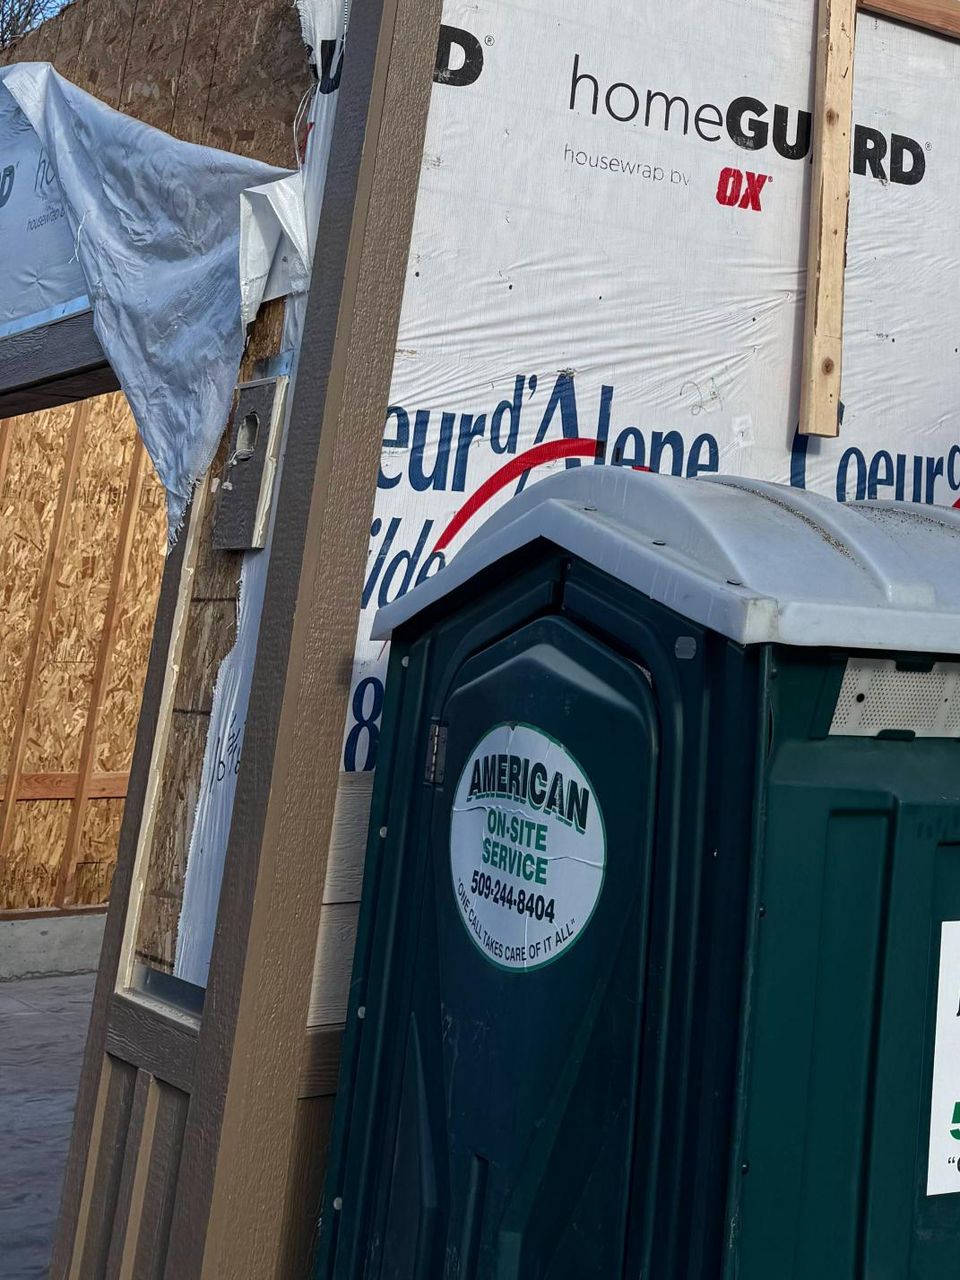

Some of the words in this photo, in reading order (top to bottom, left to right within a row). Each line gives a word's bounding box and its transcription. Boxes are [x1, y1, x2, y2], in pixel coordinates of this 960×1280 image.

[569, 53, 926, 186] homeGURD
[563, 143, 665, 182] housewrap
[716, 166, 768, 212] OX
[377, 405, 487, 492] eur
[466, 754, 590, 834] AMERICAN
[486, 809, 548, 852] ON-SITE
[481, 838, 549, 886] SERVICE
[470, 870, 556, 924] 509-244-8404
[468, 908, 483, 940] CALL
[483, 930, 504, 958] TAKES
[504, 945, 527, 962] CARE
[528, 941, 542, 960] OF
[543, 936, 552, 954] IT
